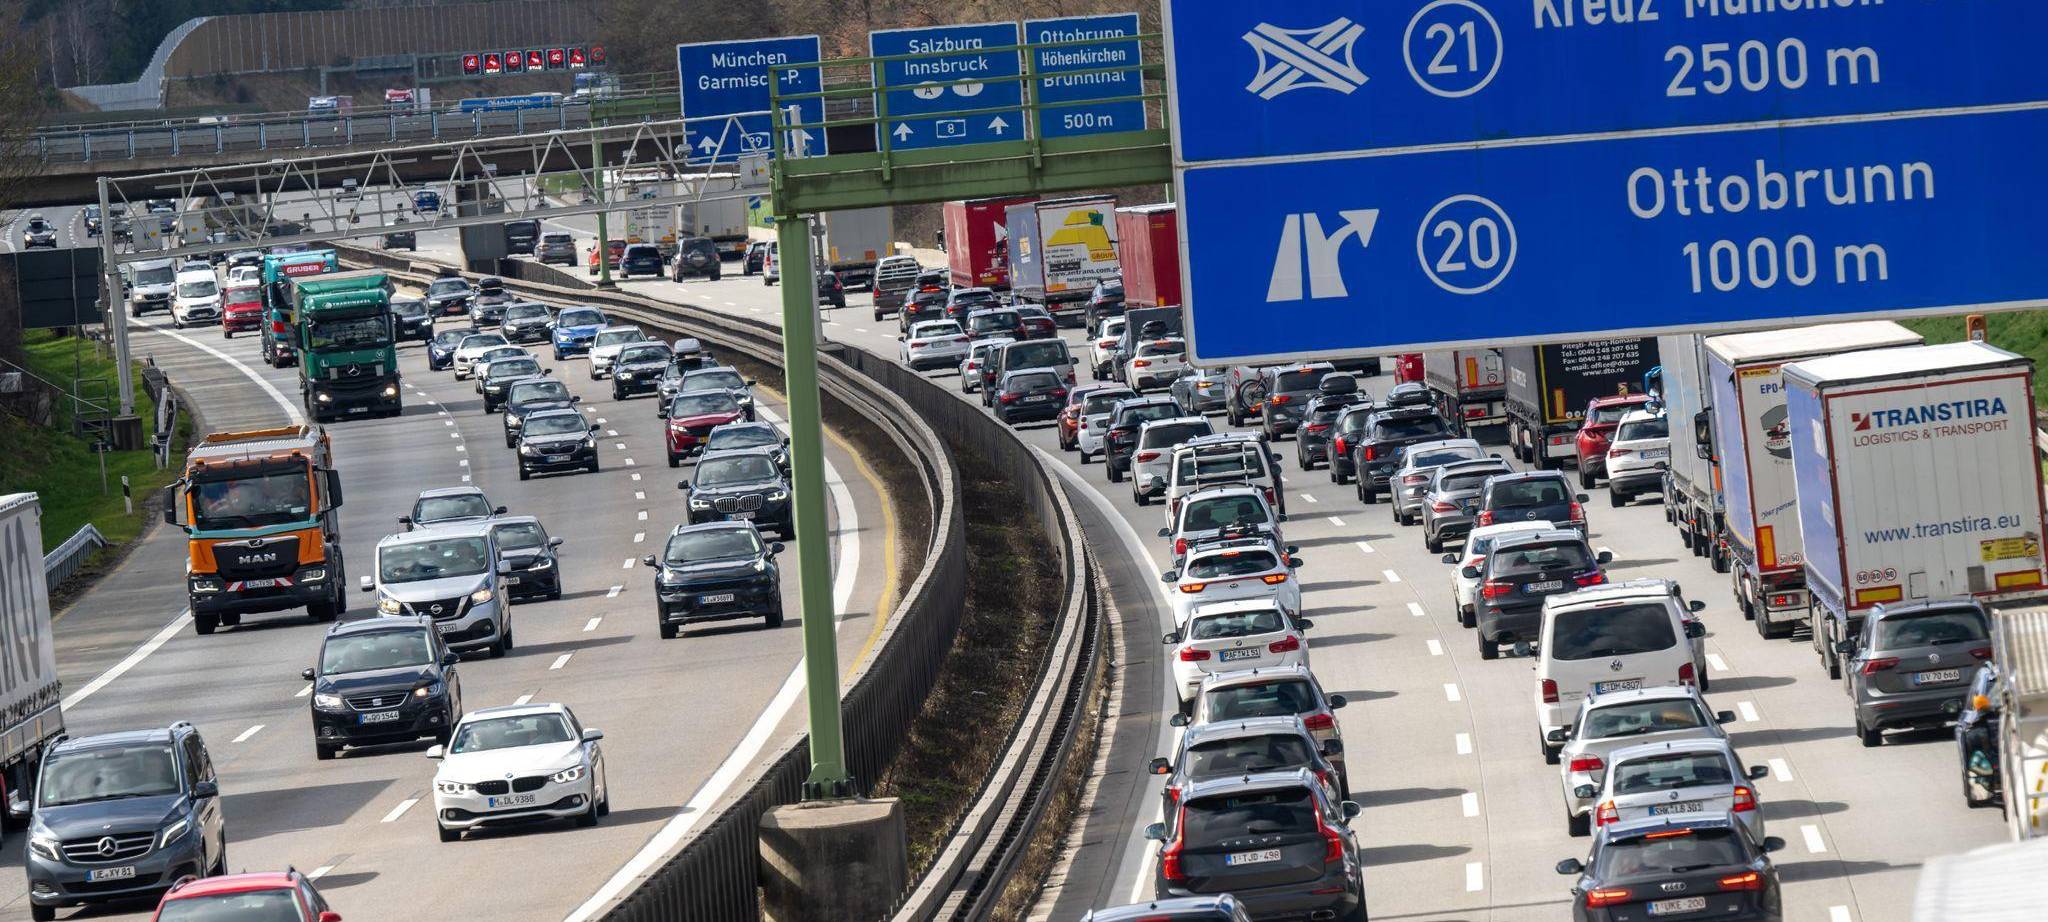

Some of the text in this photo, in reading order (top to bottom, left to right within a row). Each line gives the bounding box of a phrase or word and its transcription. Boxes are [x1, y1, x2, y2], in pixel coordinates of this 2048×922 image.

[909, 37, 983, 54] Salzburg
[1040, 28, 1124, 44] Ottobrunn
[1042, 47, 1126, 66] Höhenkirchen
[1425, 21, 1478, 74] 21
[712, 51, 787, 68] München
[905, 56, 989, 76] Innsbruck
[1664, 37, 1880, 97] 2500 m
[699, 69, 802, 90] Garmisc-P.
[947, 123, 955, 134] 8
[1064, 113, 1113, 129] 500 m
[1627, 159, 1935, 219] Ottobrunn
[1434, 220, 1502, 274] 20
[286, 265, 320, 274] GRUBER
[1683, 234, 1889, 293] 1000 m
[1871, 397, 2008, 428] TRANSTIRA
[1854, 419, 2009, 447] LOGISTICS & TRANSPORT
[1864, 512, 2021, 544] www.transtira.eu
[239, 553, 276, 564] MAN
[1221, 836, 1281, 847] VOLVO
